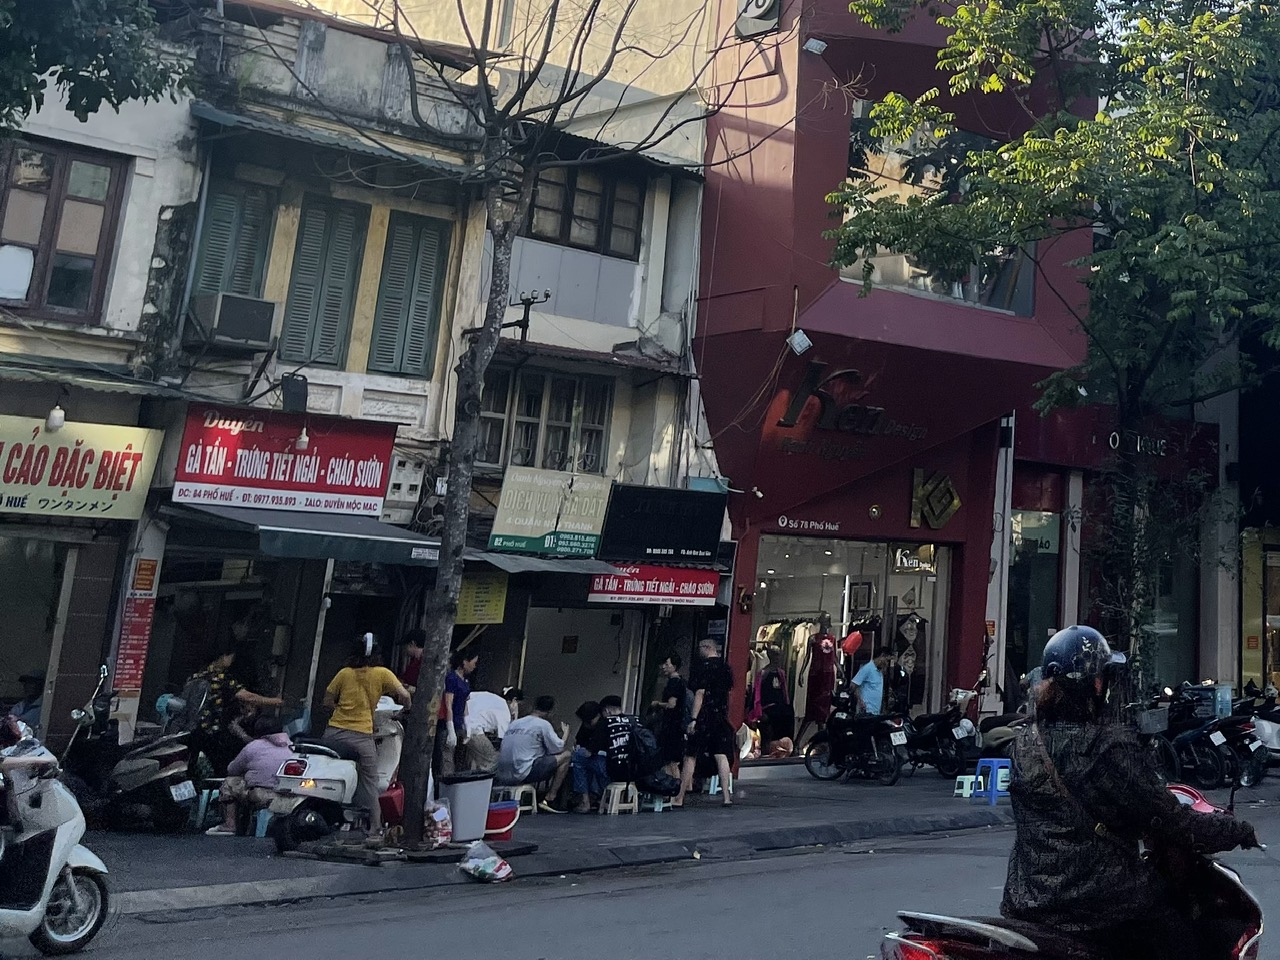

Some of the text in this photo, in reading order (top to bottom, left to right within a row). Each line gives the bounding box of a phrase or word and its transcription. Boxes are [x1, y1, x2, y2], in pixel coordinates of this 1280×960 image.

[203, 409, 264, 436] Duyên
[2, 425, 143, 501] CẢO ĐẶC BIỆT
[185, 438, 203, 474] GÀ
[203, 436, 228, 476] TẦN
[270, 444, 295, 481] TIẾT
[326, 452, 355, 487] CHÁO
[354, 453, 384, 489] SƯỜN
[5, 493, 30, 509] HUẾ
[202, 487, 220, 500] PHỐ
[219, 488, 236, 501] HUẾ
[38, 499, 113, 513] ワンタンメン
[788, 517, 840, 531] Số 78 Phố Huế
[679, 580, 697, 595] CHÁO
